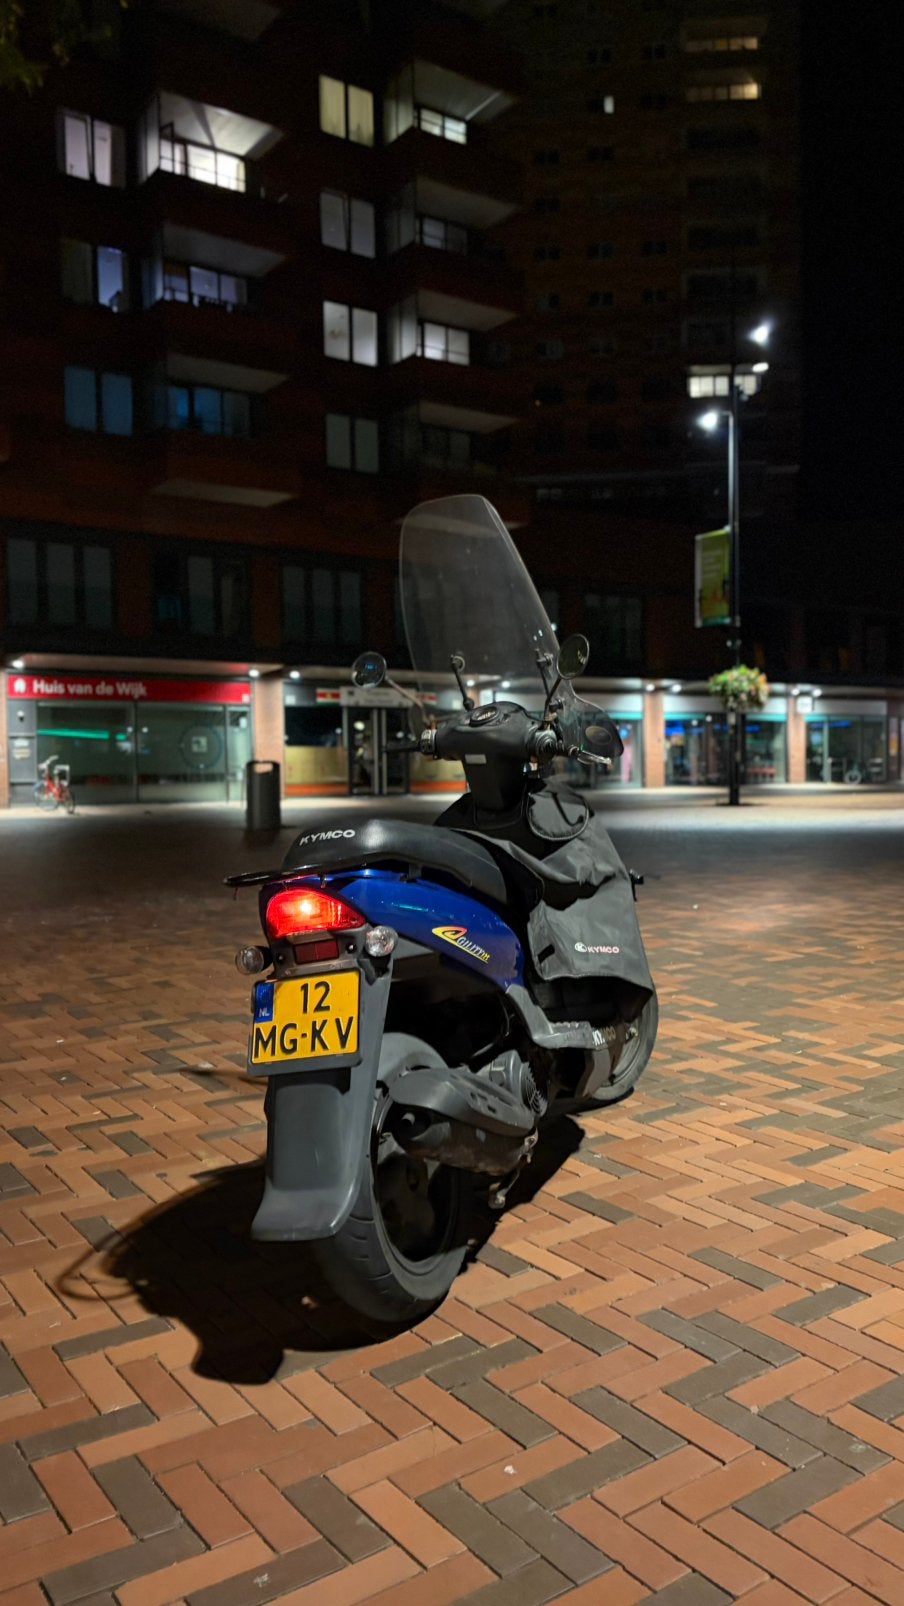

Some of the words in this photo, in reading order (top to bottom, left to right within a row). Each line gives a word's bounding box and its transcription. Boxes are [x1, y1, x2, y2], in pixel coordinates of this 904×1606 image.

[33, 679, 65, 695] Huis
[67, 683, 93, 695] van
[95, 681, 114, 695] de
[116, 682, 147, 698] Wijk
[299, 829, 356, 846] KYMCO
[587, 945, 620, 954] KYMCO
[300, 980, 331, 1014] 12
[258, 1007, 270, 1017] NL
